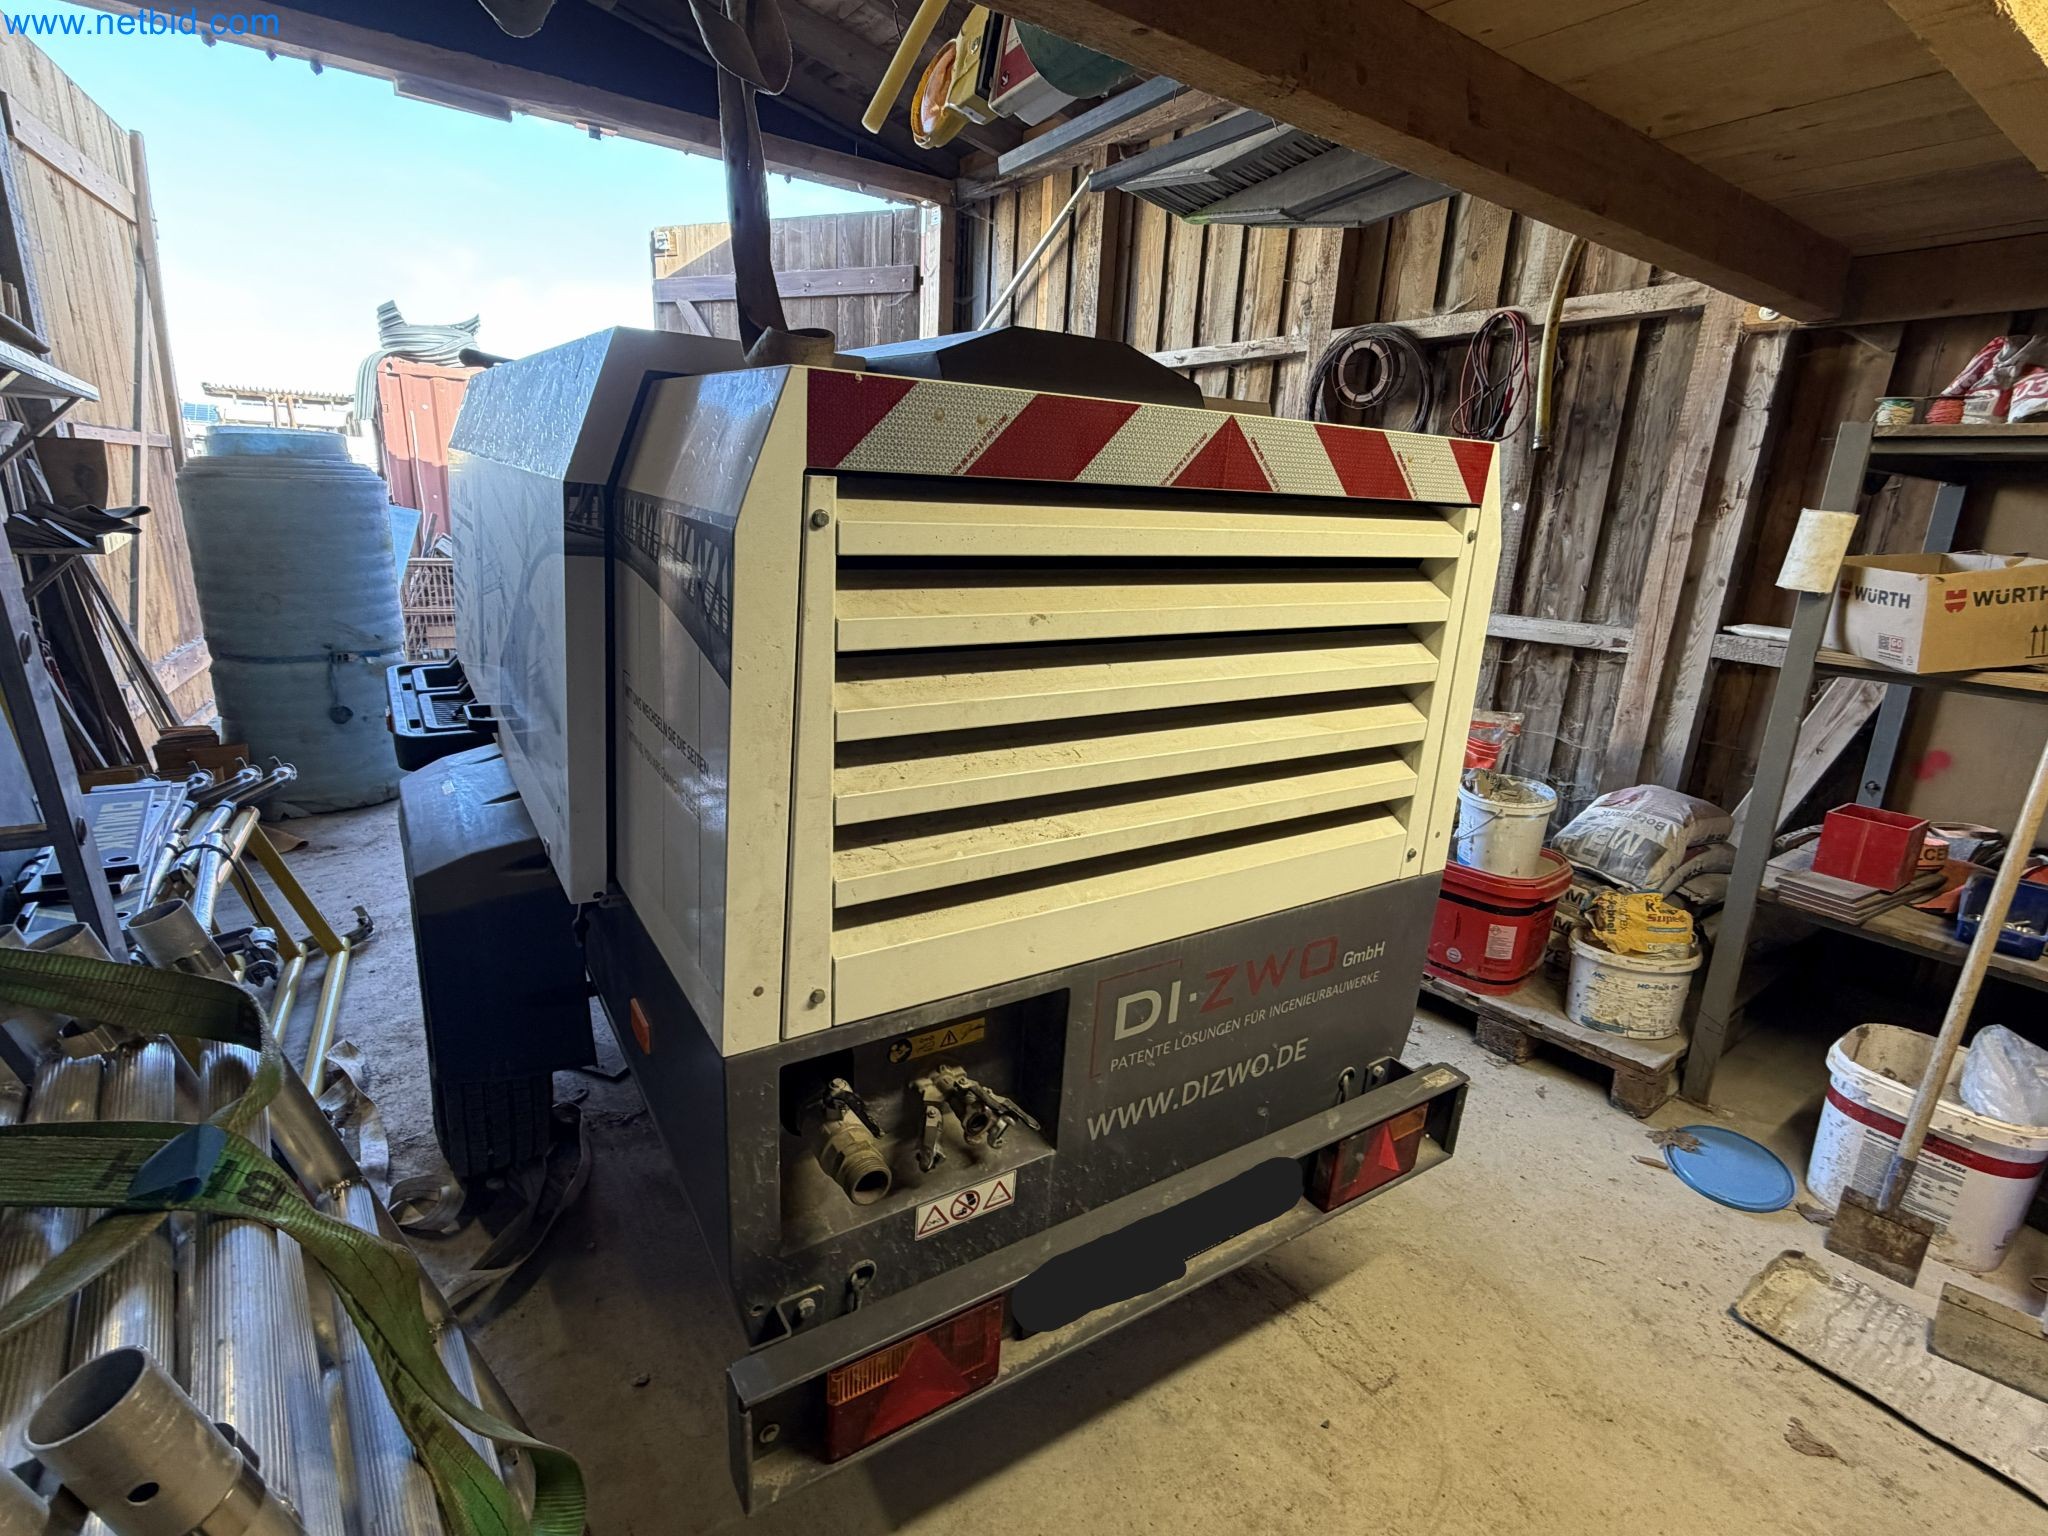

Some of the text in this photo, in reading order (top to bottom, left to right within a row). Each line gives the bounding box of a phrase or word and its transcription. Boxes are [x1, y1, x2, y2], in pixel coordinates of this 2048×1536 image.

[1855, 585, 1911, 609] WÜRTH
[1342, 941, 1386, 968] GmbH
[1110, 970, 1381, 1072] PATENTE LÖSUNGEN FÜR INGENIEURBAUWERKE
[1087, 1037, 1310, 1141] WWW.DIZWO.DE
